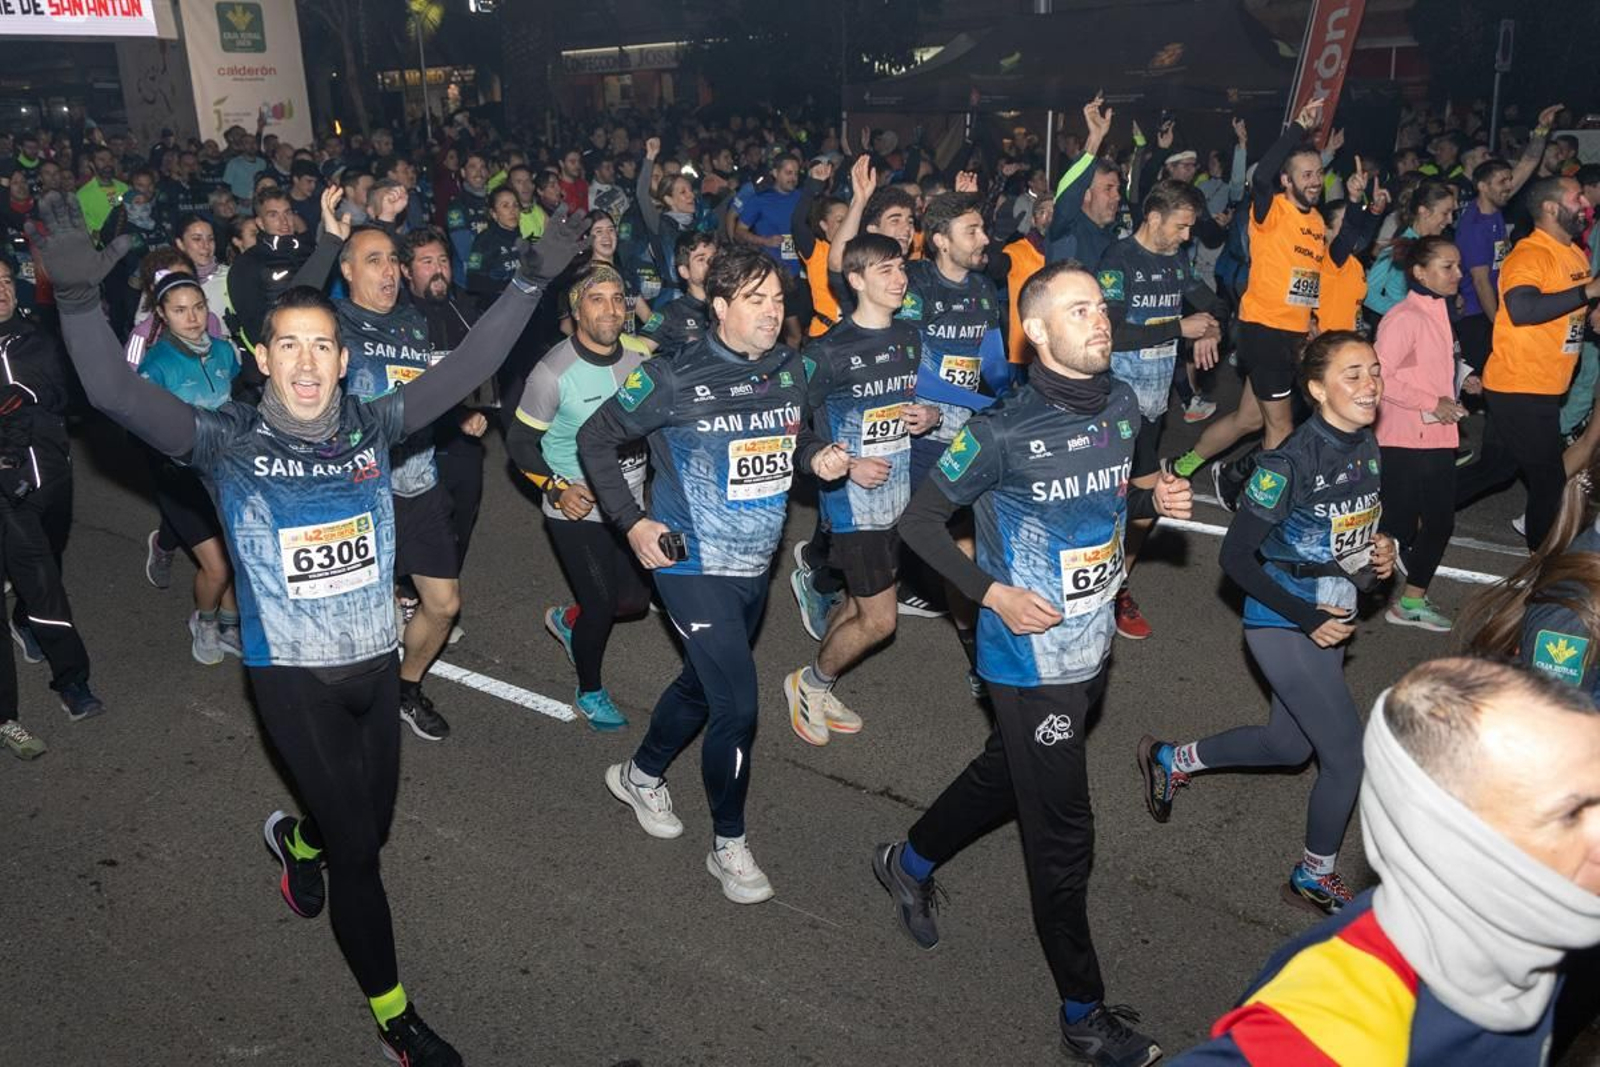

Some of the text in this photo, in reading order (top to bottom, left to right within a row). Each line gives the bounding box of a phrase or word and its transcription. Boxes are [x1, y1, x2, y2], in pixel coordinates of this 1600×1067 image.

[0, 0, 15, 15] E
[20, 0, 45, 15] DE
[49, 0, 86, 17] SAN
[217, 65, 277, 76] calderón
[1131, 294, 1157, 307] SAN
[926, 323, 956, 339] SAN
[363, 341, 397, 359] SAN
[852, 379, 884, 398] SAN
[697, 401, 801, 432] SAN ANTÓN
[253, 456, 306, 478] SAN
[736, 452, 789, 478] 6053
[1031, 475, 1080, 502] SAN
[1313, 499, 1352, 518] SAN
[303, 528, 323, 542] 42
[1335, 521, 1374, 553] 5411
[292, 535, 369, 573] 6306
[1083, 549, 1101, 563] 42
